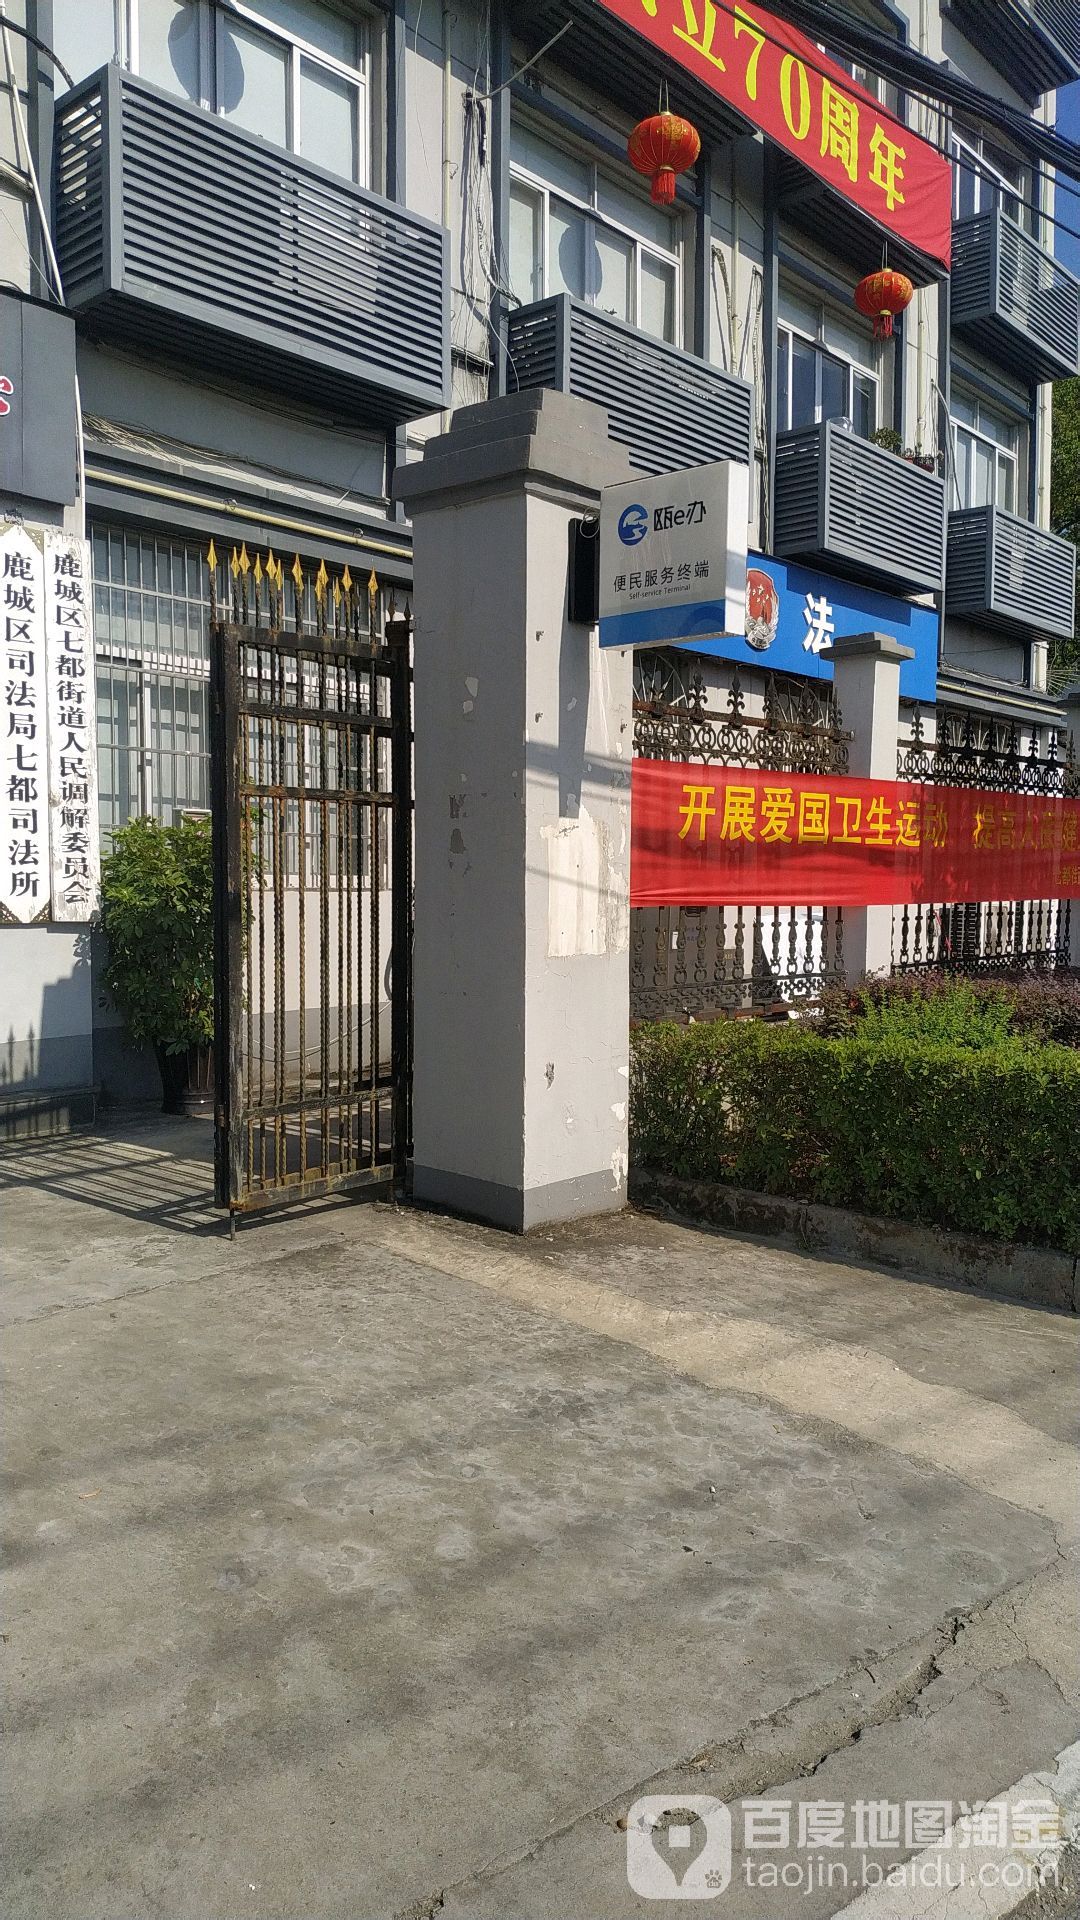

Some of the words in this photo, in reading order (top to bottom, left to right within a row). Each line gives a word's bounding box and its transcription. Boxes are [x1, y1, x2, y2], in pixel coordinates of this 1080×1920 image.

[641, 0, 906, 211] 立70周年
[613, 560, 710, 592] 便民服务终端
[629, 589, 662, 600] Self-service
[664, 584, 691, 595] Terminal
[802, 592, 835, 653] 法
[2, 551, 40, 897] 鹿城区司法局七都司法所
[53, 554, 91, 904] 鹿城区七都街道人民调解委员会
[678, 785, 949, 848] 开展爱国卫生运动
